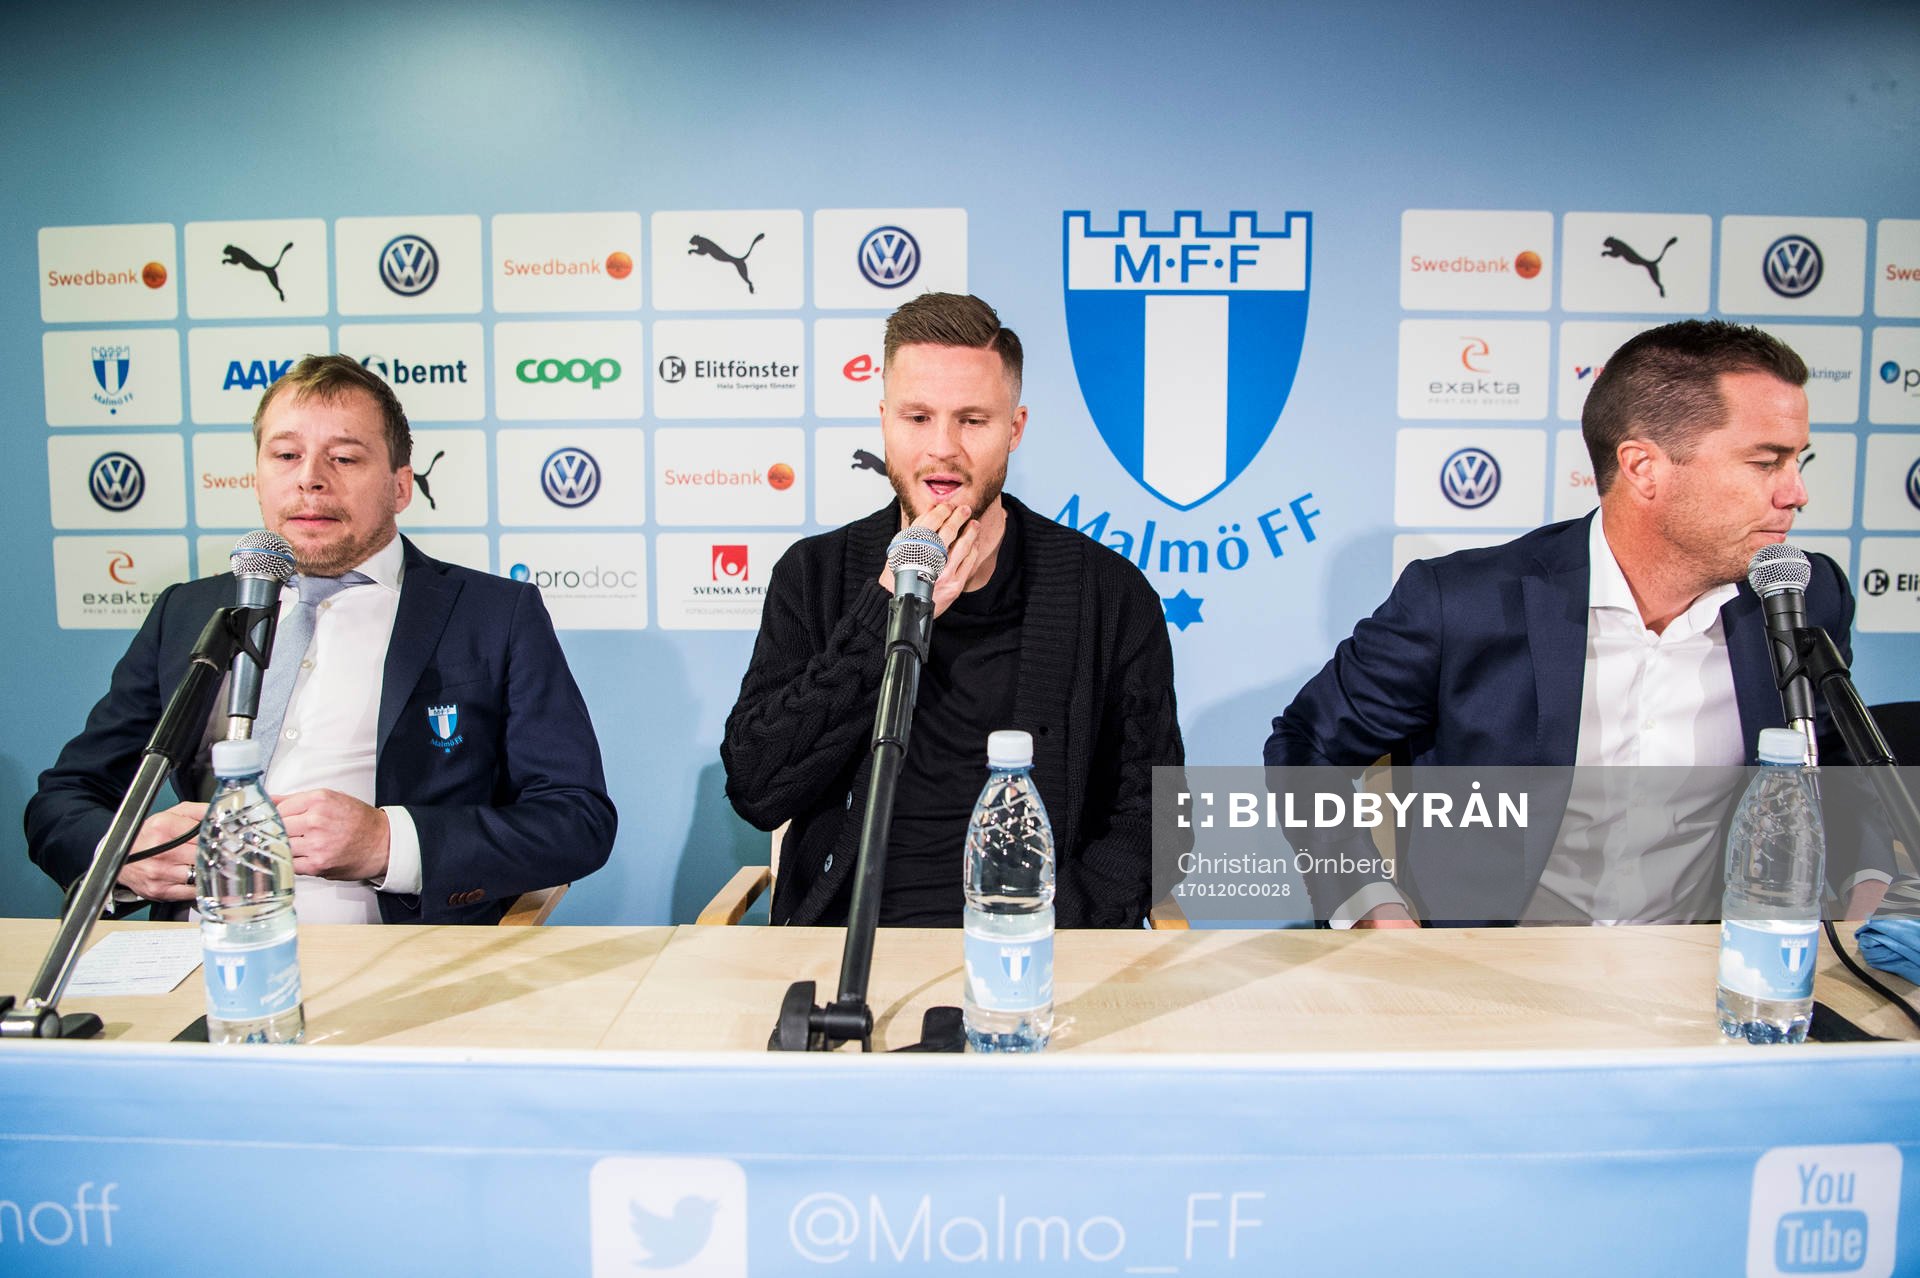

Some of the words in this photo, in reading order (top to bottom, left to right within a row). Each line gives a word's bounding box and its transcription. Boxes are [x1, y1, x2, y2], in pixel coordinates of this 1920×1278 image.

[503, 259, 601, 276] Swedbank
[1411, 256, 1510, 273] Swedbank
[48, 271, 138, 287] Swedbank
[394, 359, 467, 383] bemt
[515, 357, 622, 390] coop
[695, 360, 799, 378] Elitfönster
[1429, 379, 1520, 394] exakta
[664, 468, 762, 486] Swedbank
[1257, 492, 1322, 559] FF
[535, 565, 638, 590] prodoc
[693, 586, 741, 595] SVENSKA
[1797, 1163, 1855, 1205] You
[789, 1192, 1266, 1273] @Malmo_FF
[1782, 1218, 1863, 1265] Tube
